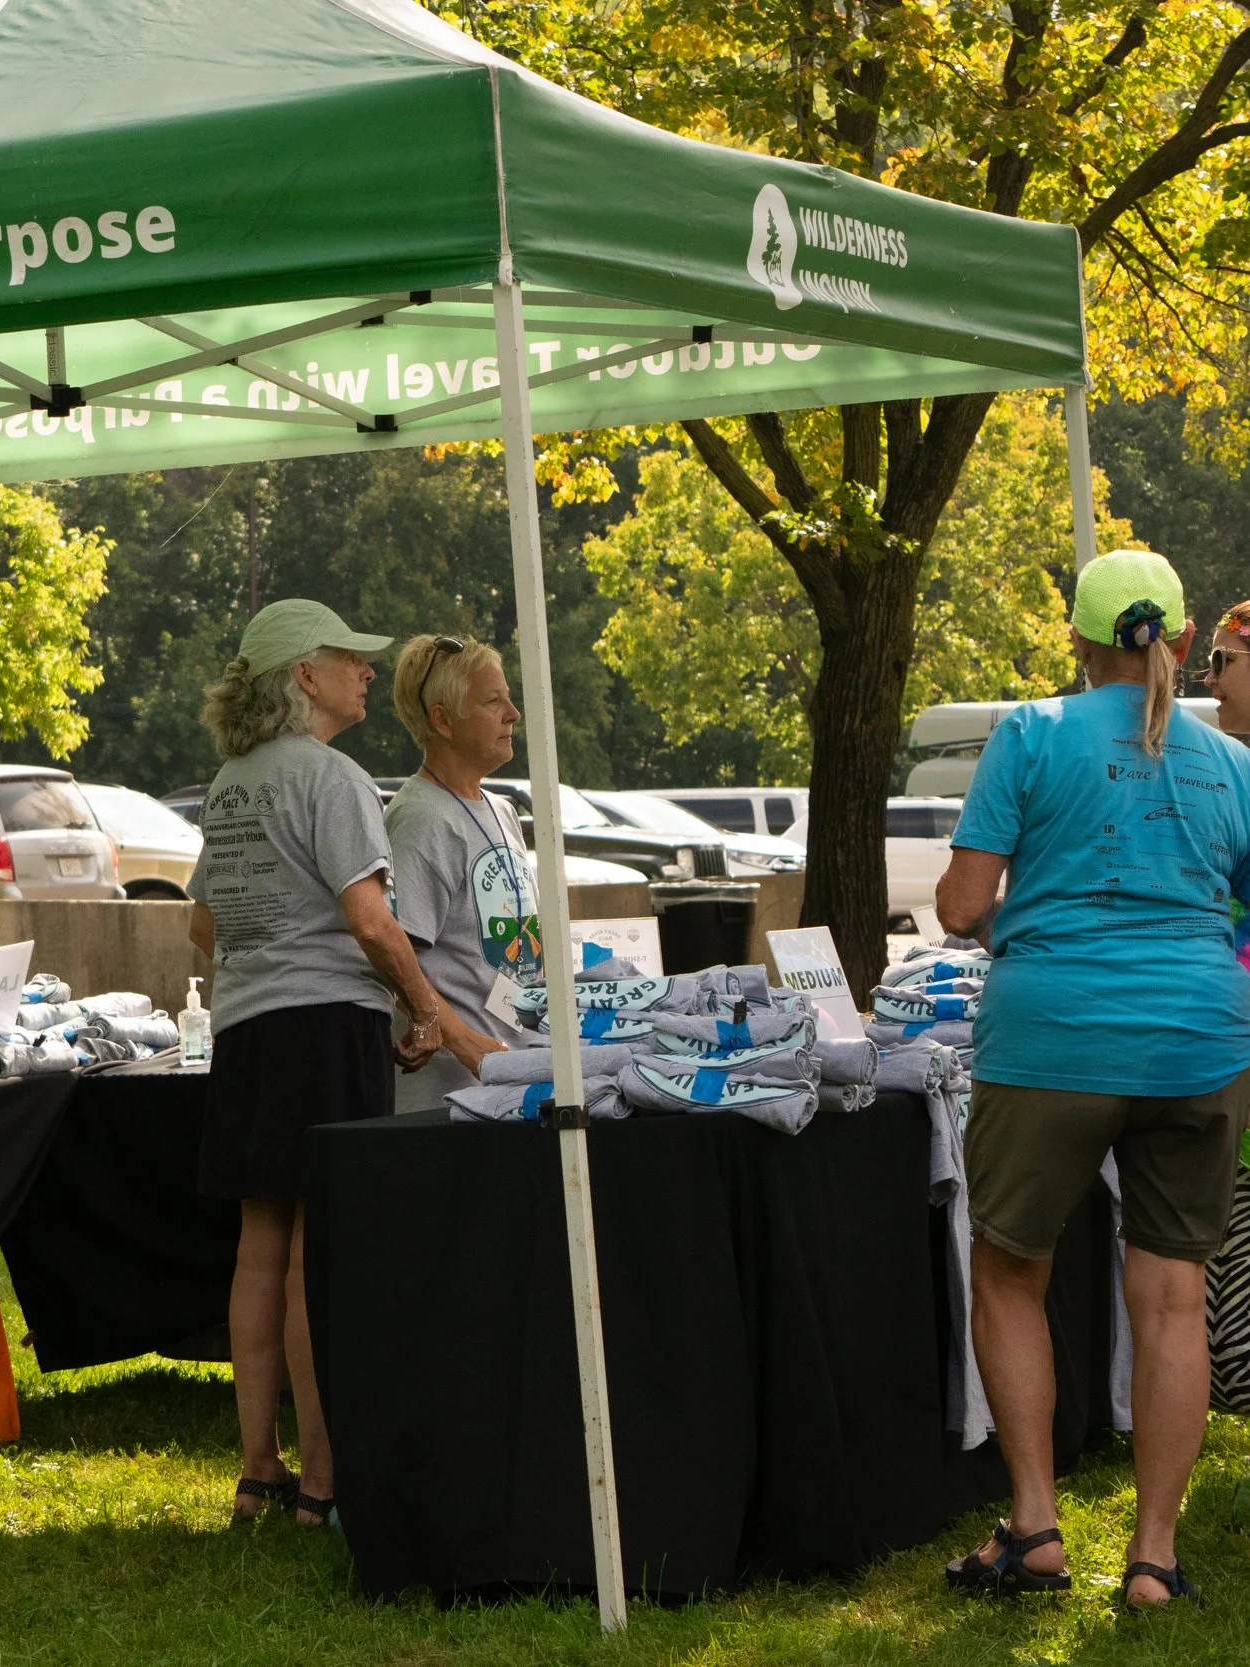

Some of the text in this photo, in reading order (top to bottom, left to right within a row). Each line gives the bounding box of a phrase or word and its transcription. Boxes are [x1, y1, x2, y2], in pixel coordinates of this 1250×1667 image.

[799, 206, 908, 268] WILDERNESS
[799, 269, 882, 314] INQUIRY
[1173, 775, 1220, 793] TRAVELERS
[210, 785, 235, 810] GREAT
[235, 784, 250, 807] RIVER
[221, 798, 239, 810] RACE
[212, 887, 240, 895] SPONSORED
[575, 982, 618, 996] RAC
[784, 967, 846, 991] MEDIUM
[884, 997, 937, 1017] RIVE
